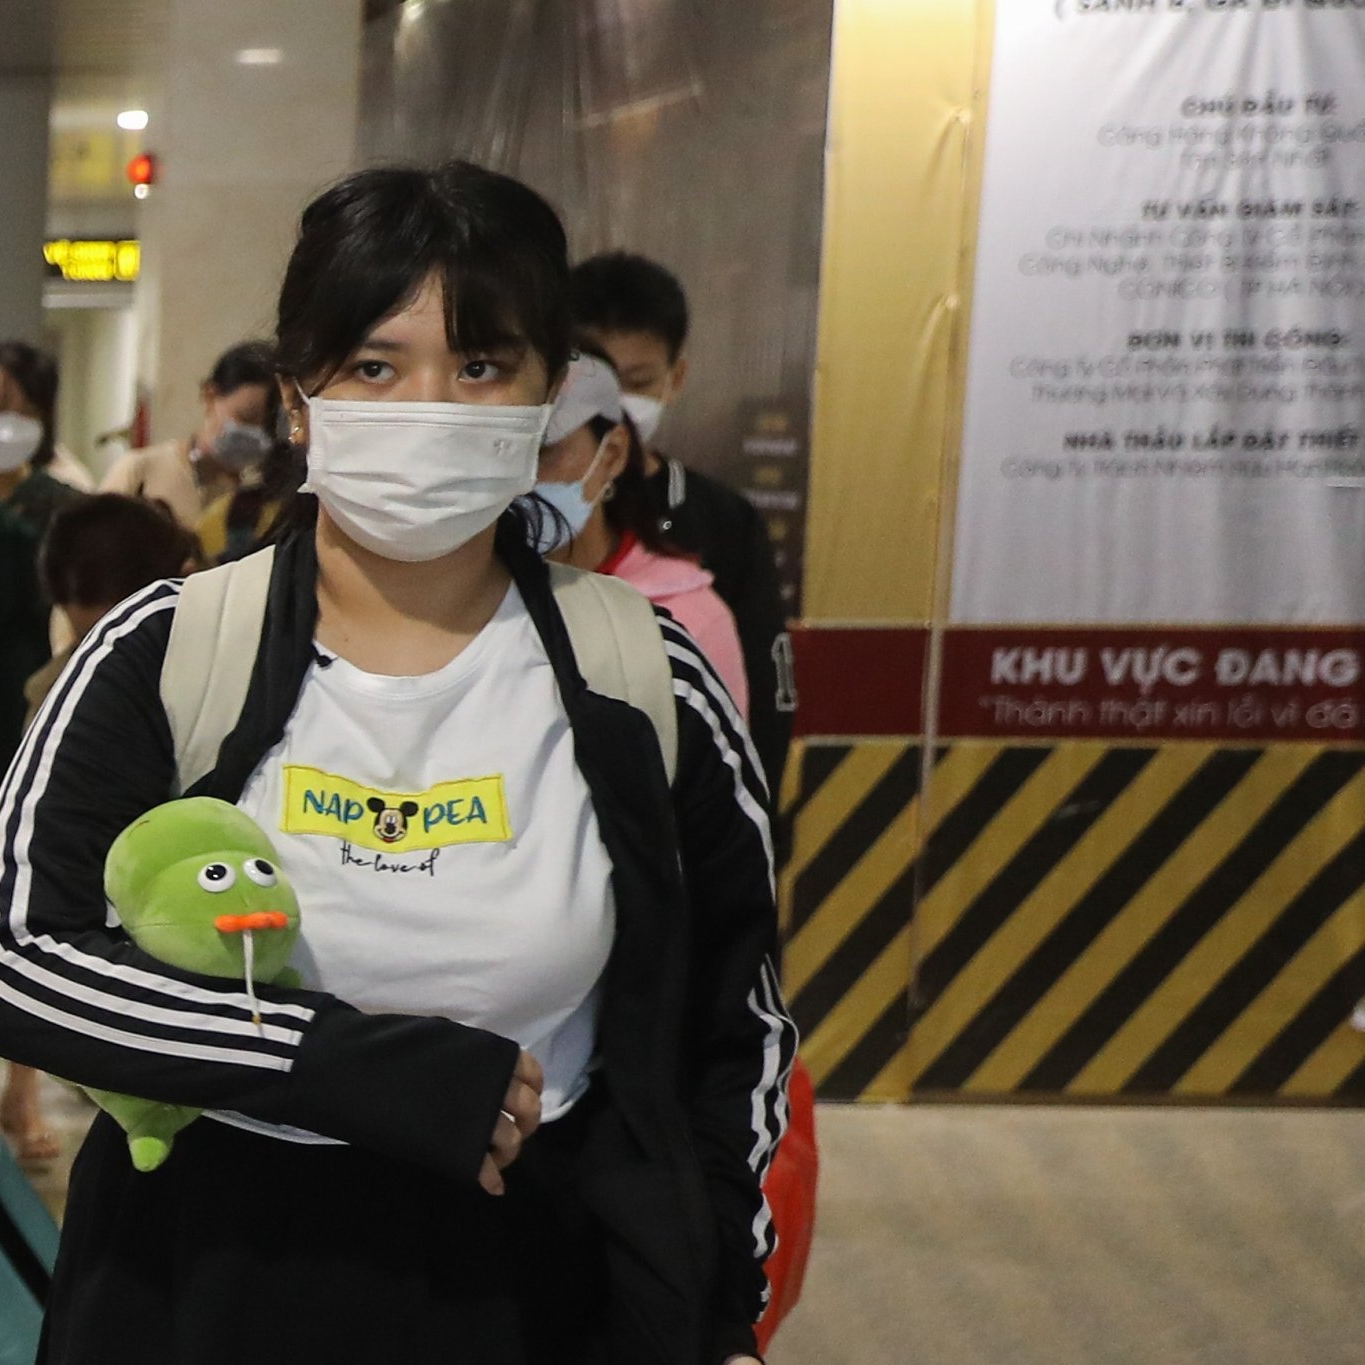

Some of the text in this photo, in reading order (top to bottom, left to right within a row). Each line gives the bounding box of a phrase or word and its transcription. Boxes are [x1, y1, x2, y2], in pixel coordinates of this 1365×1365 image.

[990, 640, 1361, 695] KHU VỰC ĐANG
[1172, 699, 1217, 728] xin
[303, 789, 487, 833] NAP PEA
[341, 841, 440, 876] the love of
